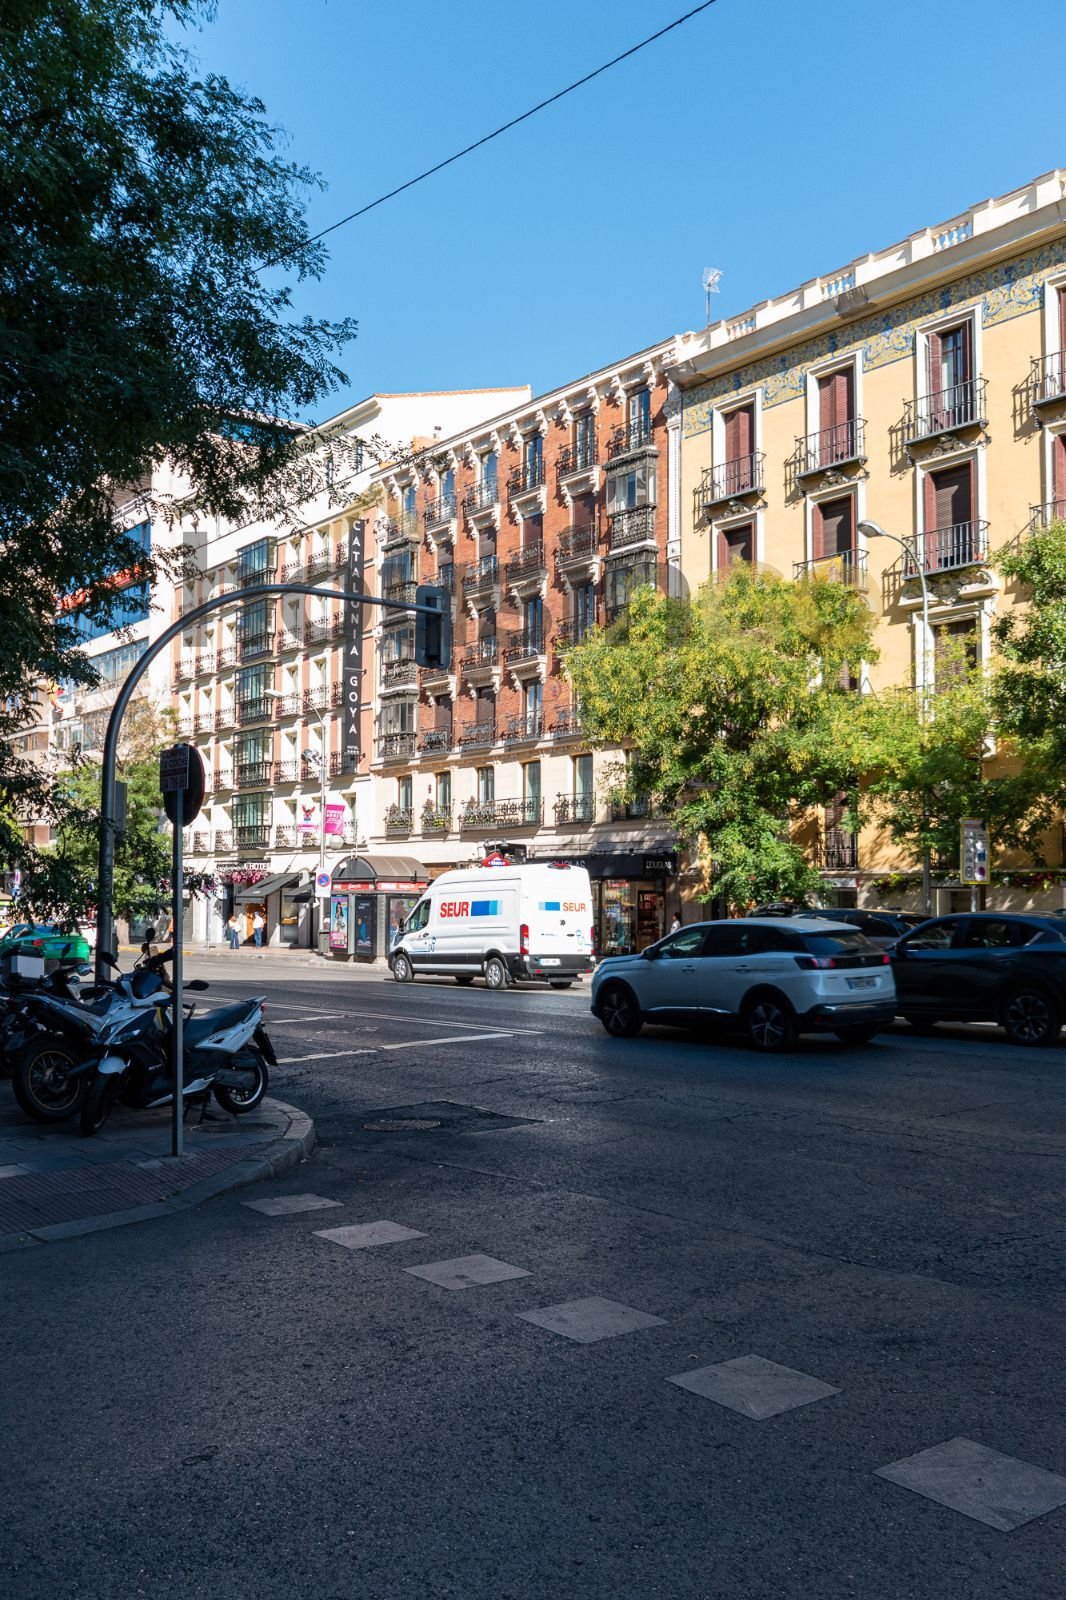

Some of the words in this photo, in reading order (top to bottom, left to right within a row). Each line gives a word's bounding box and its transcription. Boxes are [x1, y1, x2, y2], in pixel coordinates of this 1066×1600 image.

[349, 676, 358, 734] GOYA
[440, 902, 469, 918] SEUR
[562, 902, 586, 912] SEUR
